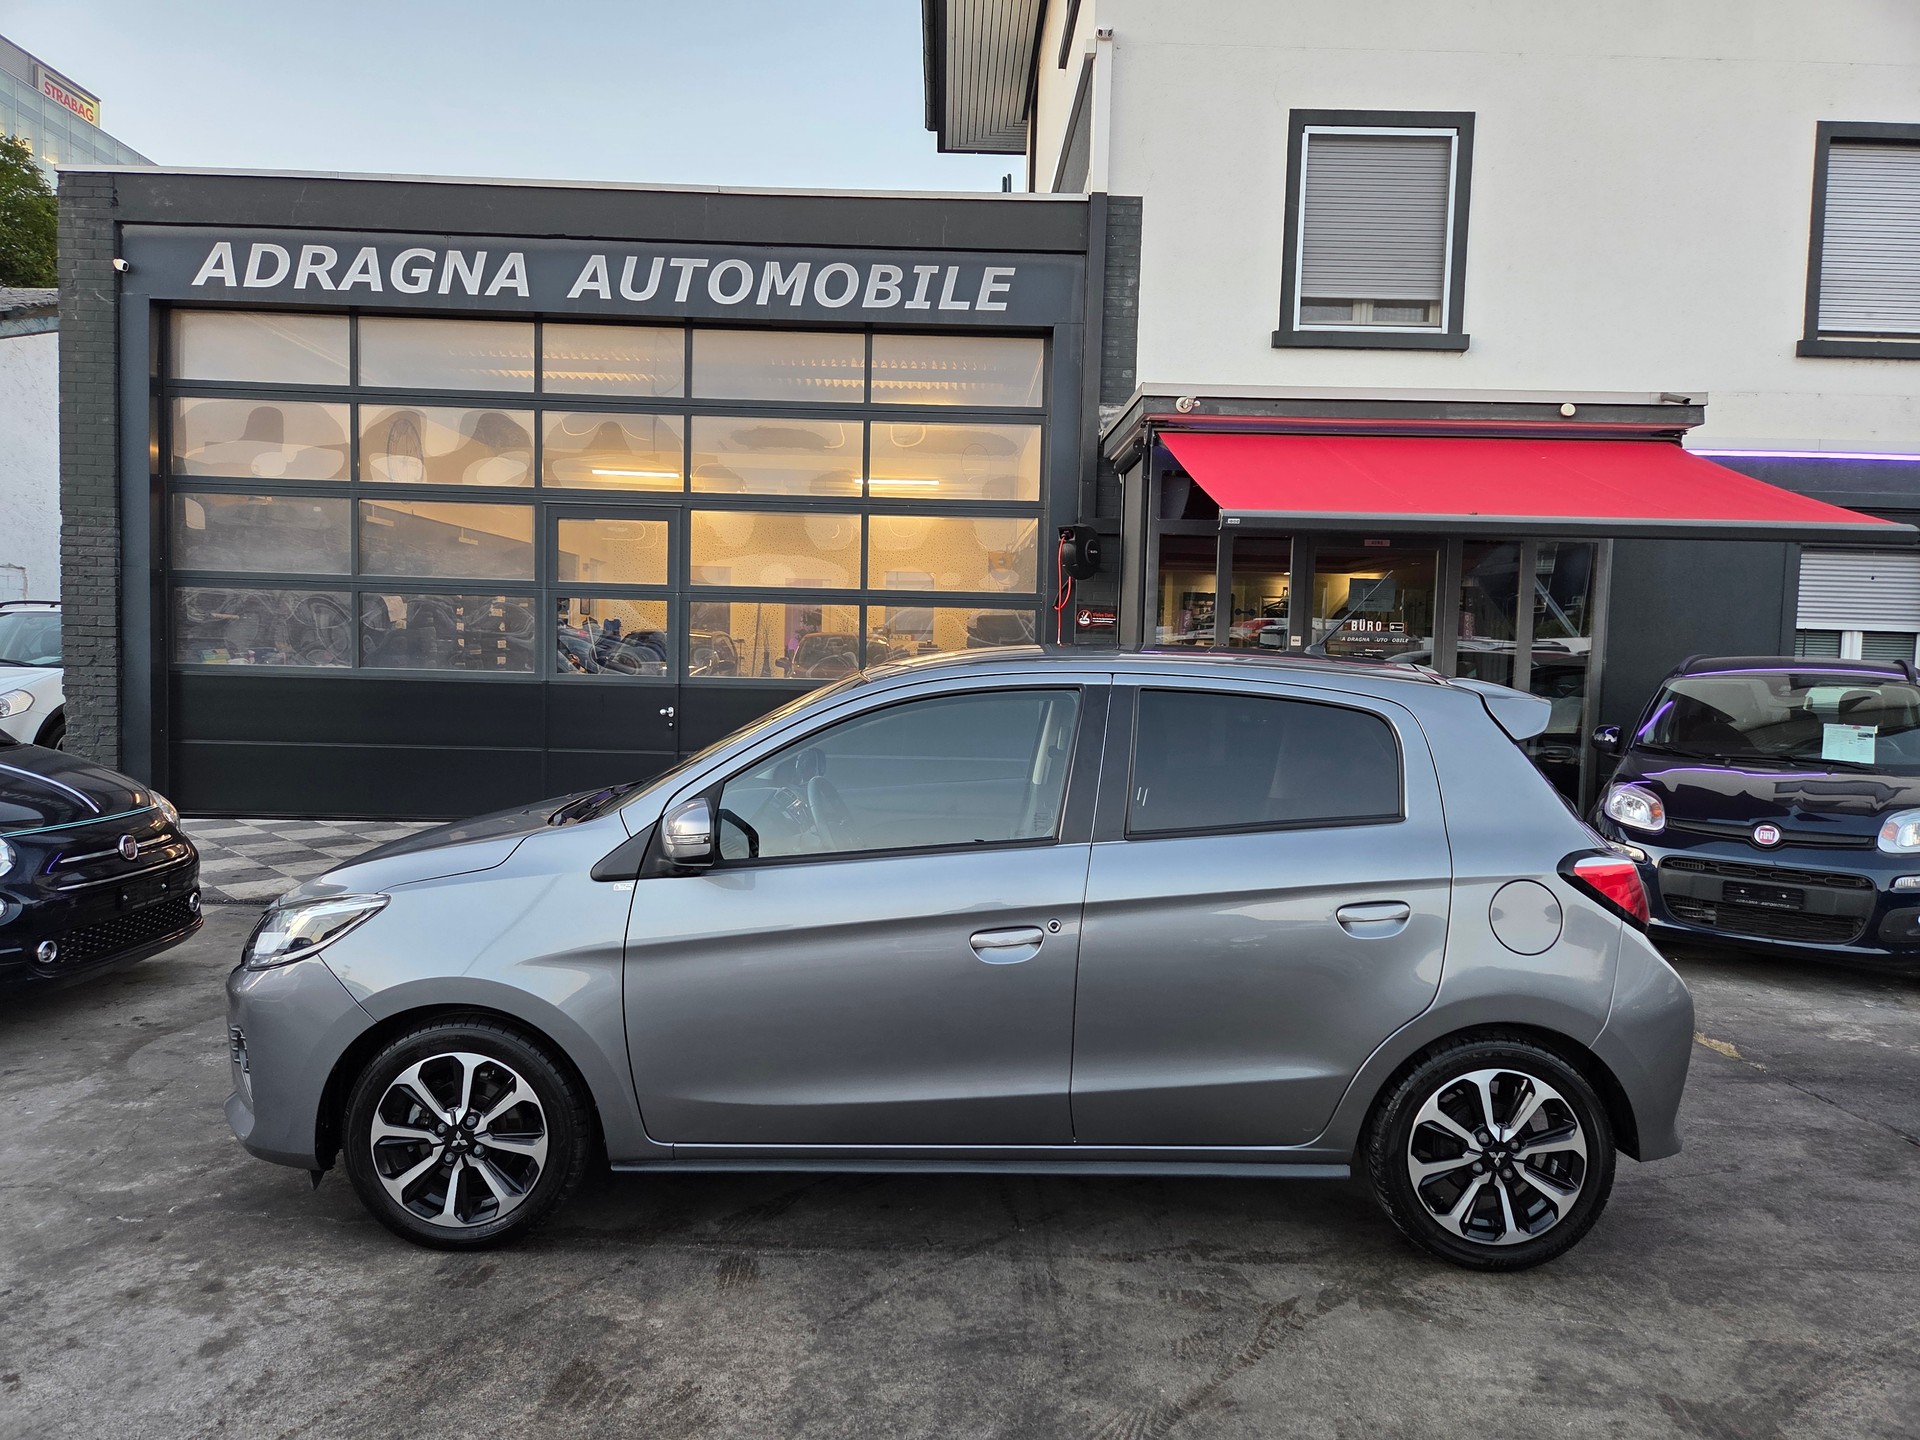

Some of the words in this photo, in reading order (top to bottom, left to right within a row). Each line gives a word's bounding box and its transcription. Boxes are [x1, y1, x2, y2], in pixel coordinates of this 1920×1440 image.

[44, 81, 94, 122] STRABAG
[191, 242, 530, 297] ADRAGNA
[567, 255, 1016, 311] AUTOMOBILE
[1351, 619, 1382, 632] BÜRO
[1760, 830, 1775, 840] FIAT
